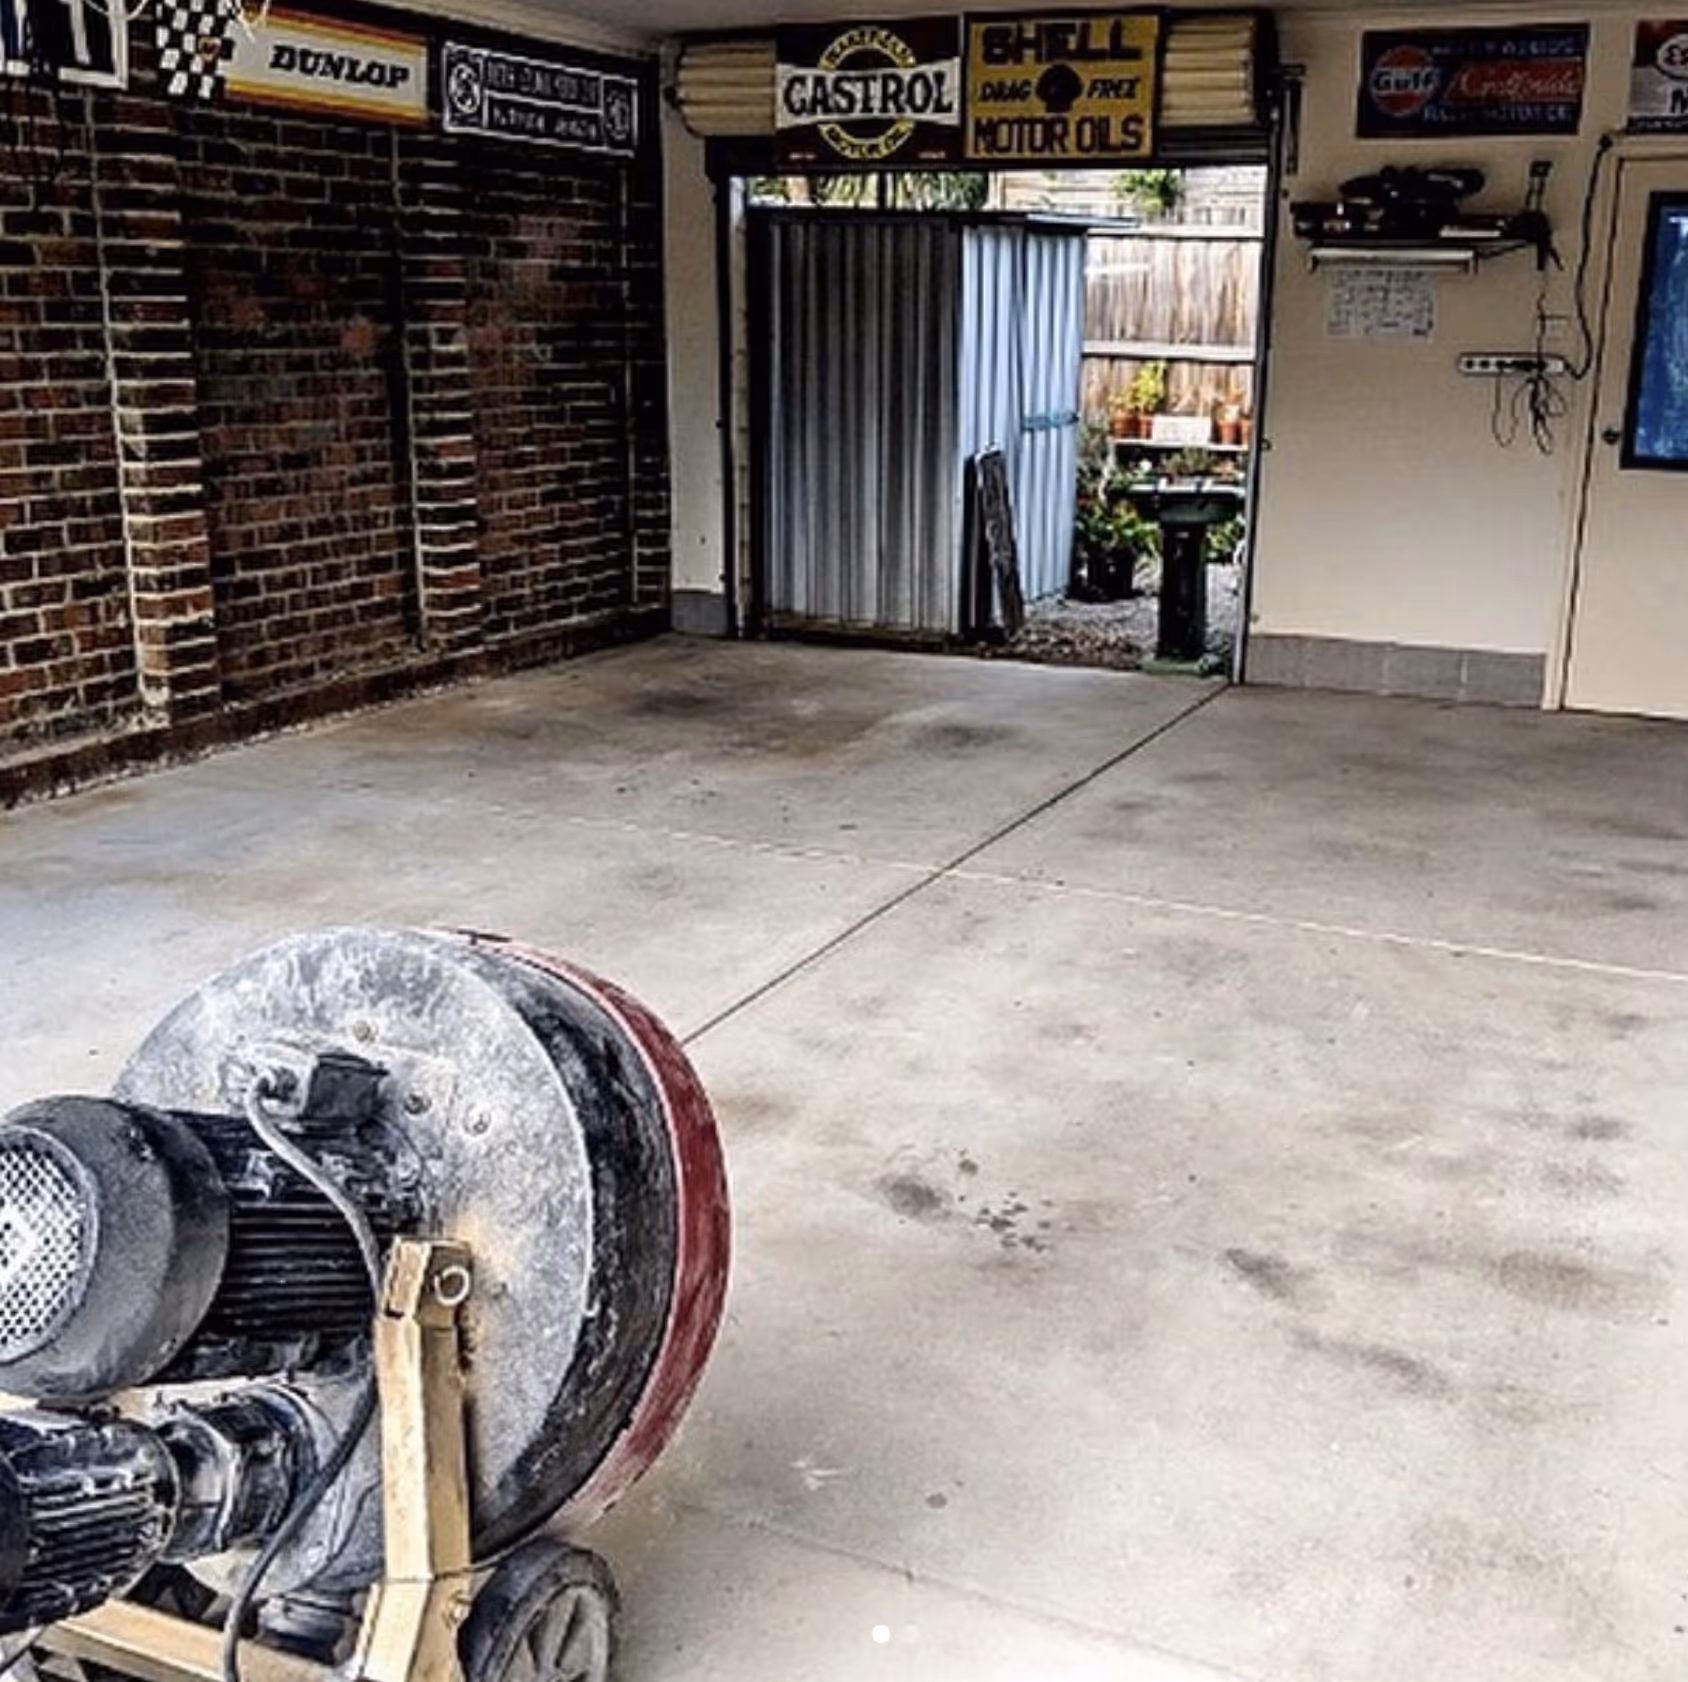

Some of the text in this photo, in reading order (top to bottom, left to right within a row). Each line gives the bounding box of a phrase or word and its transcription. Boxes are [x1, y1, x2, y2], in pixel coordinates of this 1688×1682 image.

[982, 19, 1142, 65] SHELL
[269, 44, 410, 88] DUNLOP
[784, 70, 953, 115] CASTROL
[973, 113, 1144, 153] MOTOR OILS
